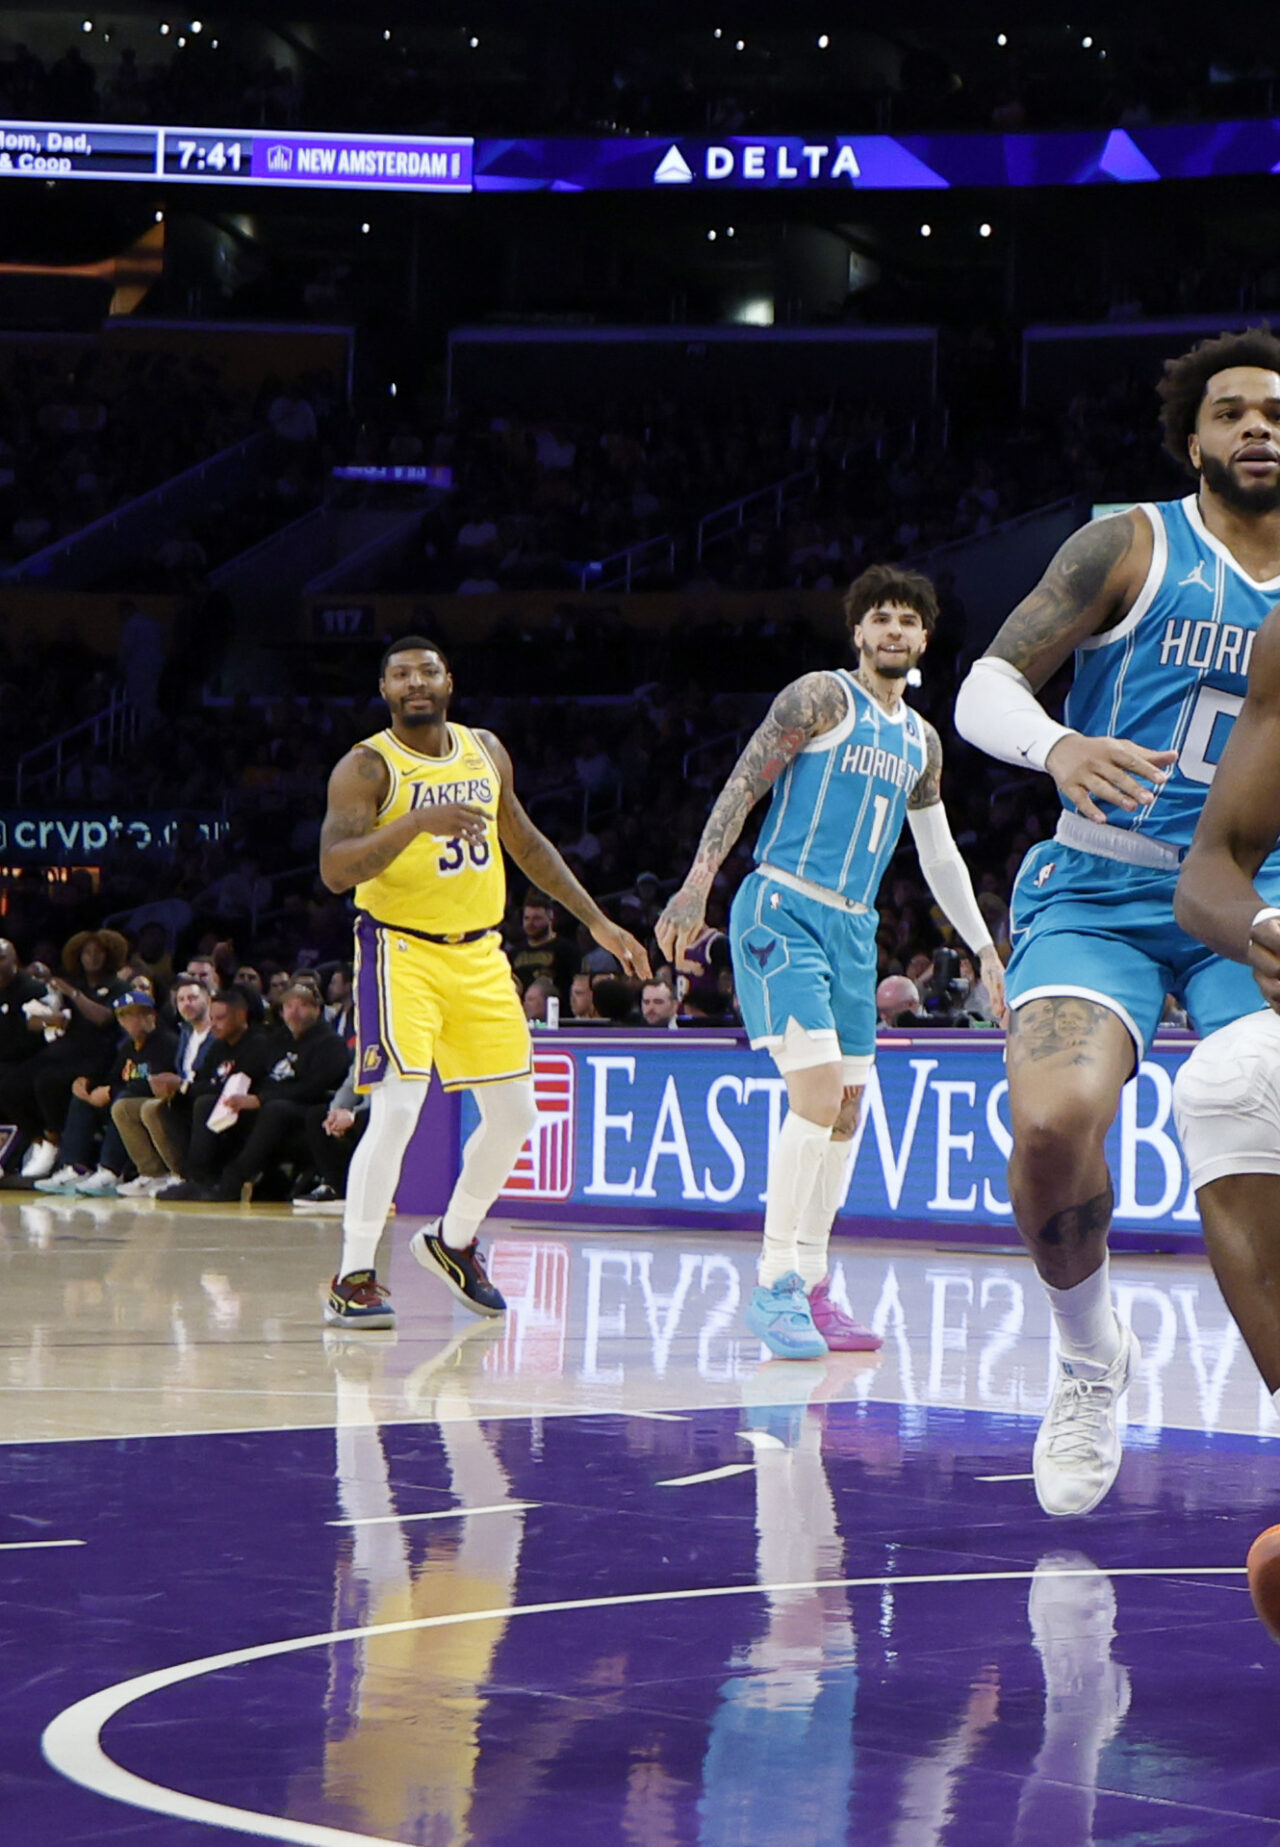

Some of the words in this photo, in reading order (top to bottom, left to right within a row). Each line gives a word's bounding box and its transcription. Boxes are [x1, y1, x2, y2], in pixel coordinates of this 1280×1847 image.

[47, 132, 91, 155] Dad,
[177, 140, 241, 171] 7:41
[18, 153, 71, 173] Coop
[297, 148, 337, 174] NEW
[338, 149, 447, 178] AMSTERDAM
[706, 145, 861, 179] DELTA
[411, 778, 492, 811] LAKERS
[14, 814, 230, 856] crypto.
[867, 794, 890, 854] 1
[584, 1056, 789, 1203] EAST
[838, 1059, 1014, 1217] WES
